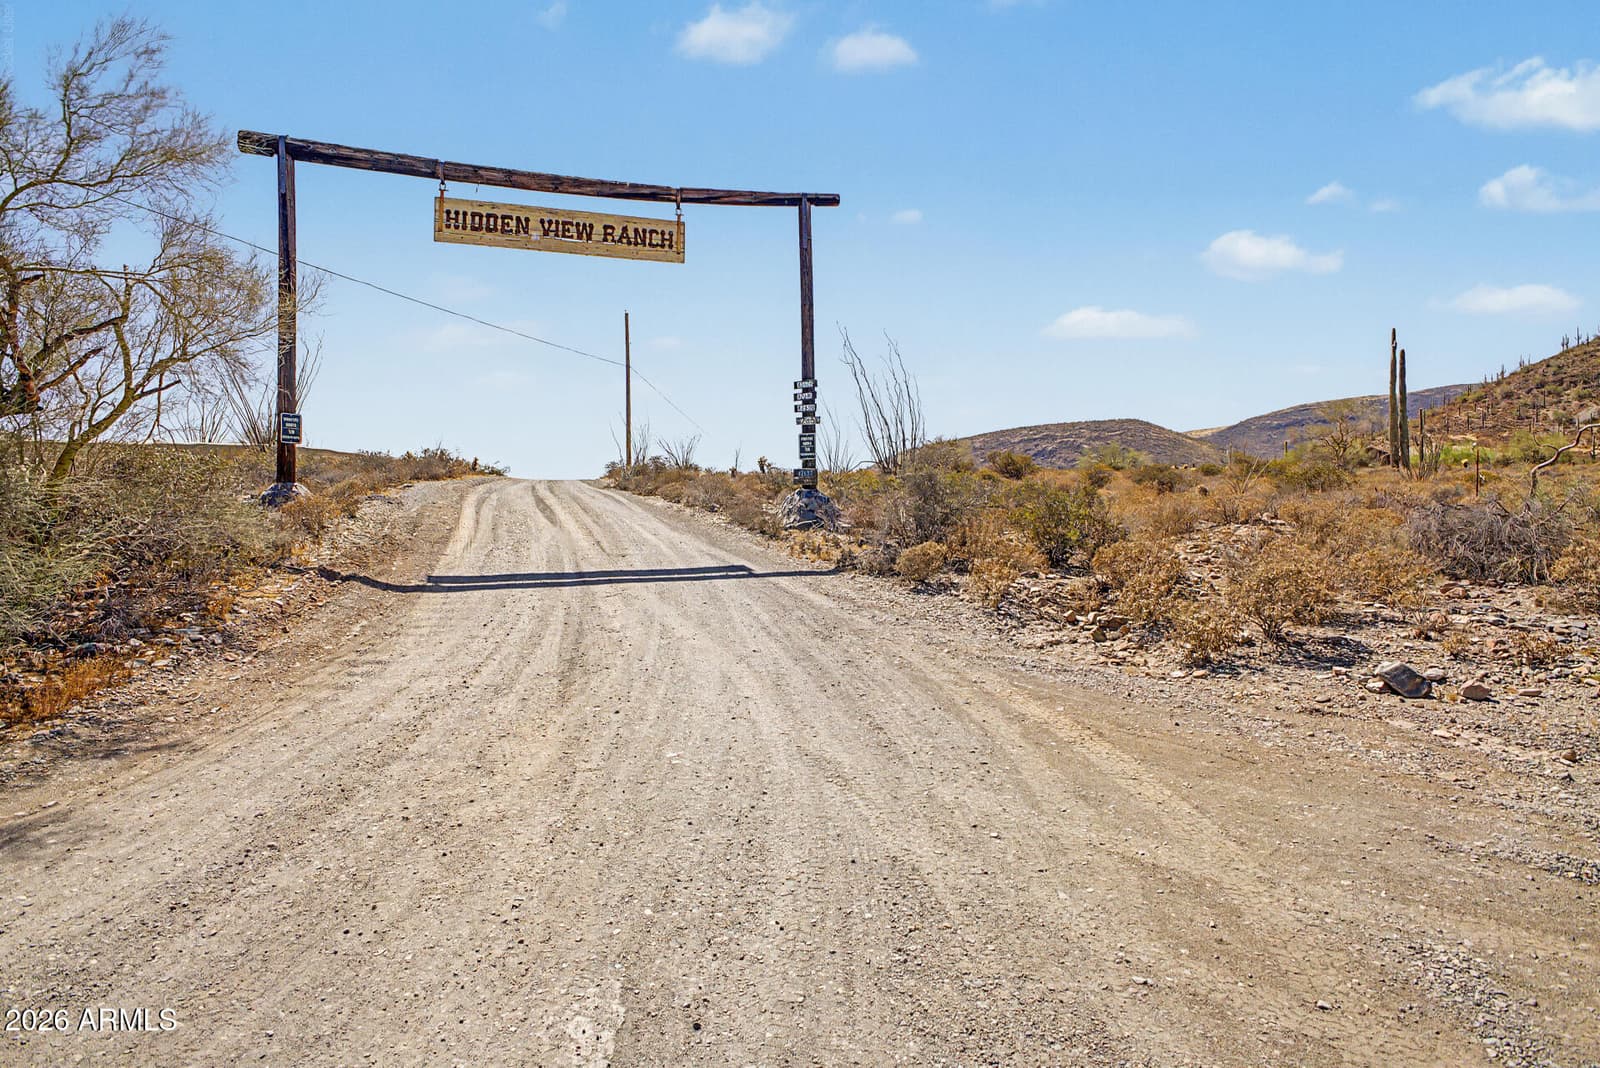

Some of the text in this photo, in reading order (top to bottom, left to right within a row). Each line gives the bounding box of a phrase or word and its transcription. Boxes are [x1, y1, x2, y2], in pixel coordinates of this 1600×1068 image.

[445, 209, 674, 250] HIDDEN VIEW RANCH
